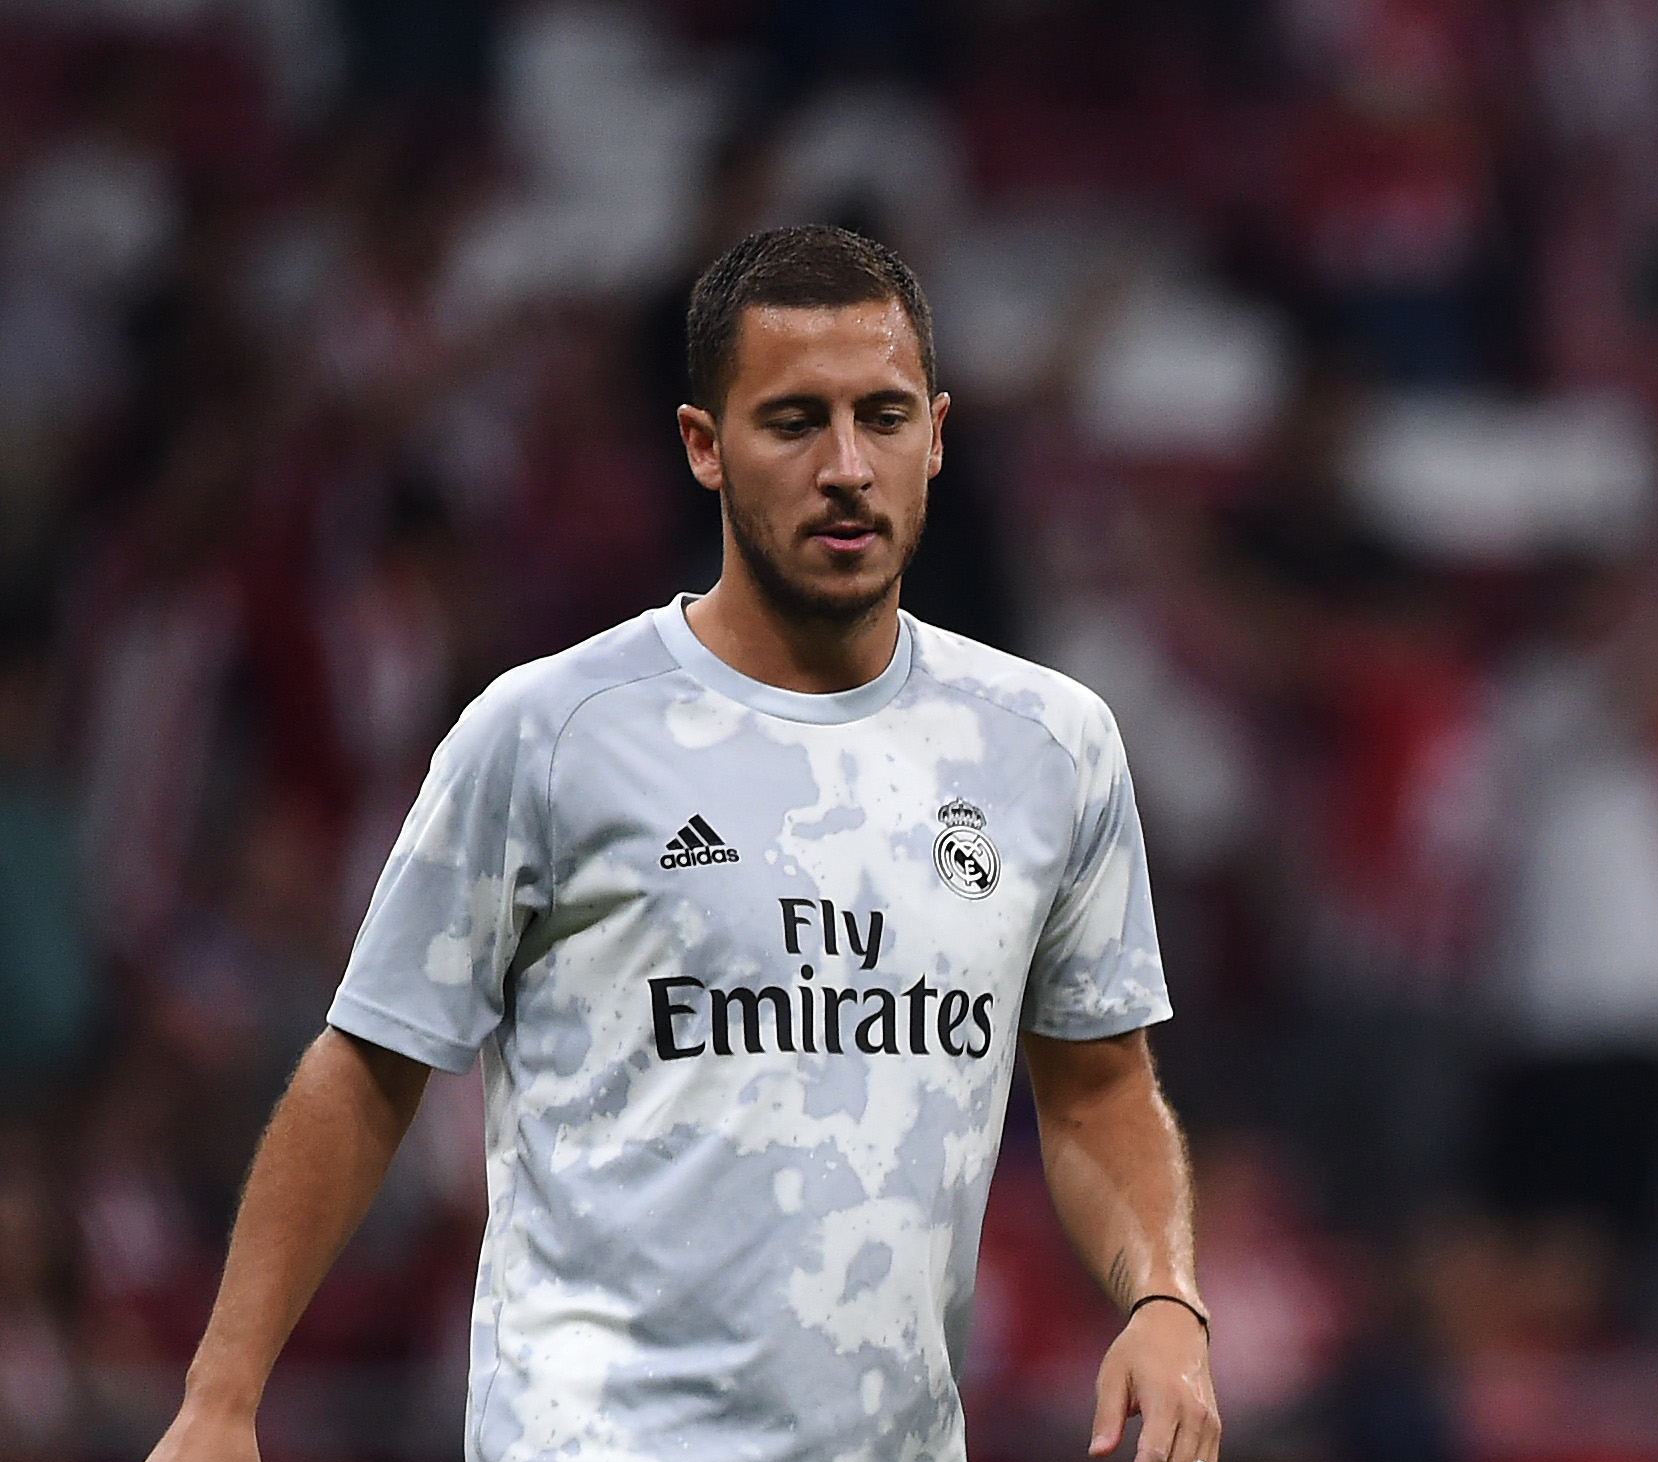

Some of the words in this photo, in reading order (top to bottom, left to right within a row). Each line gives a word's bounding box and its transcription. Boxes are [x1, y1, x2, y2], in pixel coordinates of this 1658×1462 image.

[659, 846, 740, 869] adidas
[778, 898, 884, 970] Fly
[647, 964, 993, 1060] Emirates
